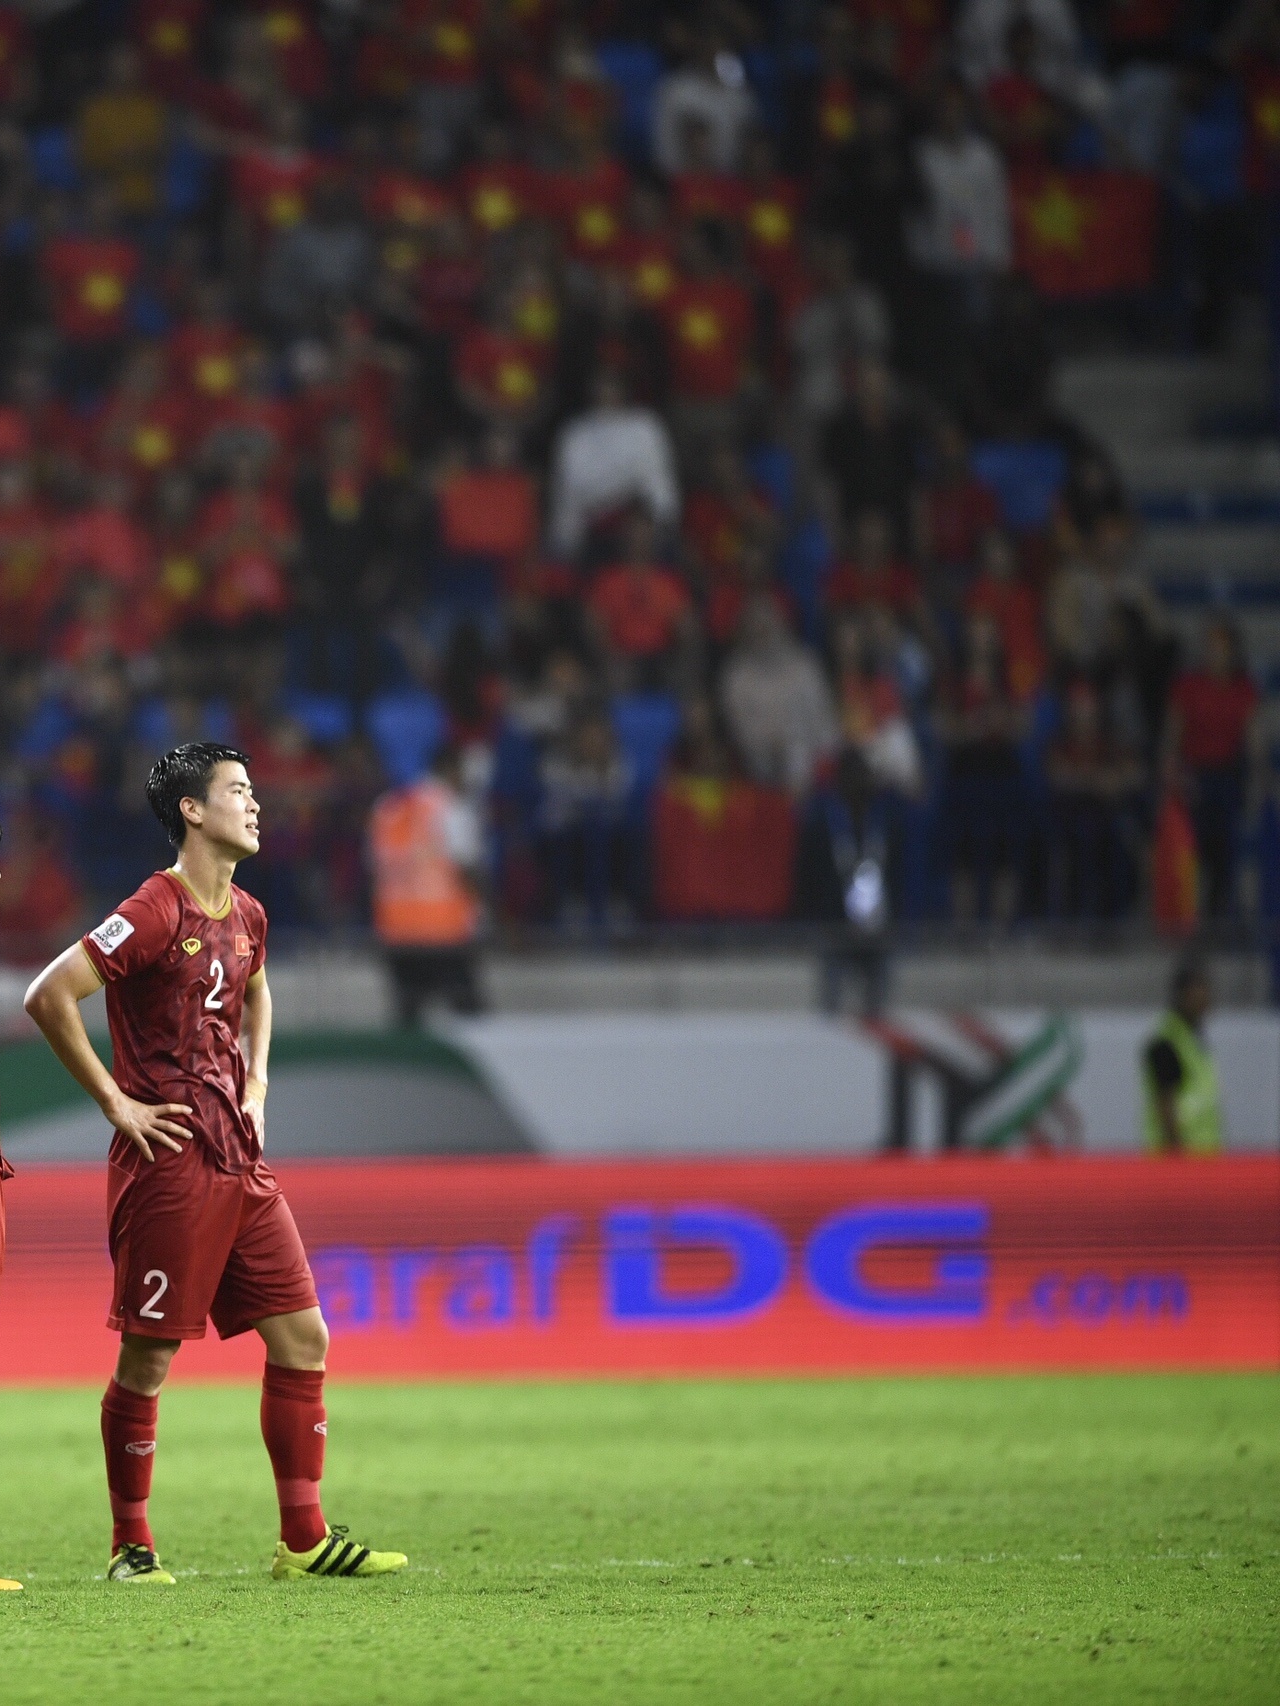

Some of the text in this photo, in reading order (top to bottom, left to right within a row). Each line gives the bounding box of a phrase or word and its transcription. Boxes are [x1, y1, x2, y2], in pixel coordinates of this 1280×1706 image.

[204, 959, 224, 1009] 2
[600, 1201, 992, 1328] DG
[139, 1269, 168, 1320] 2
